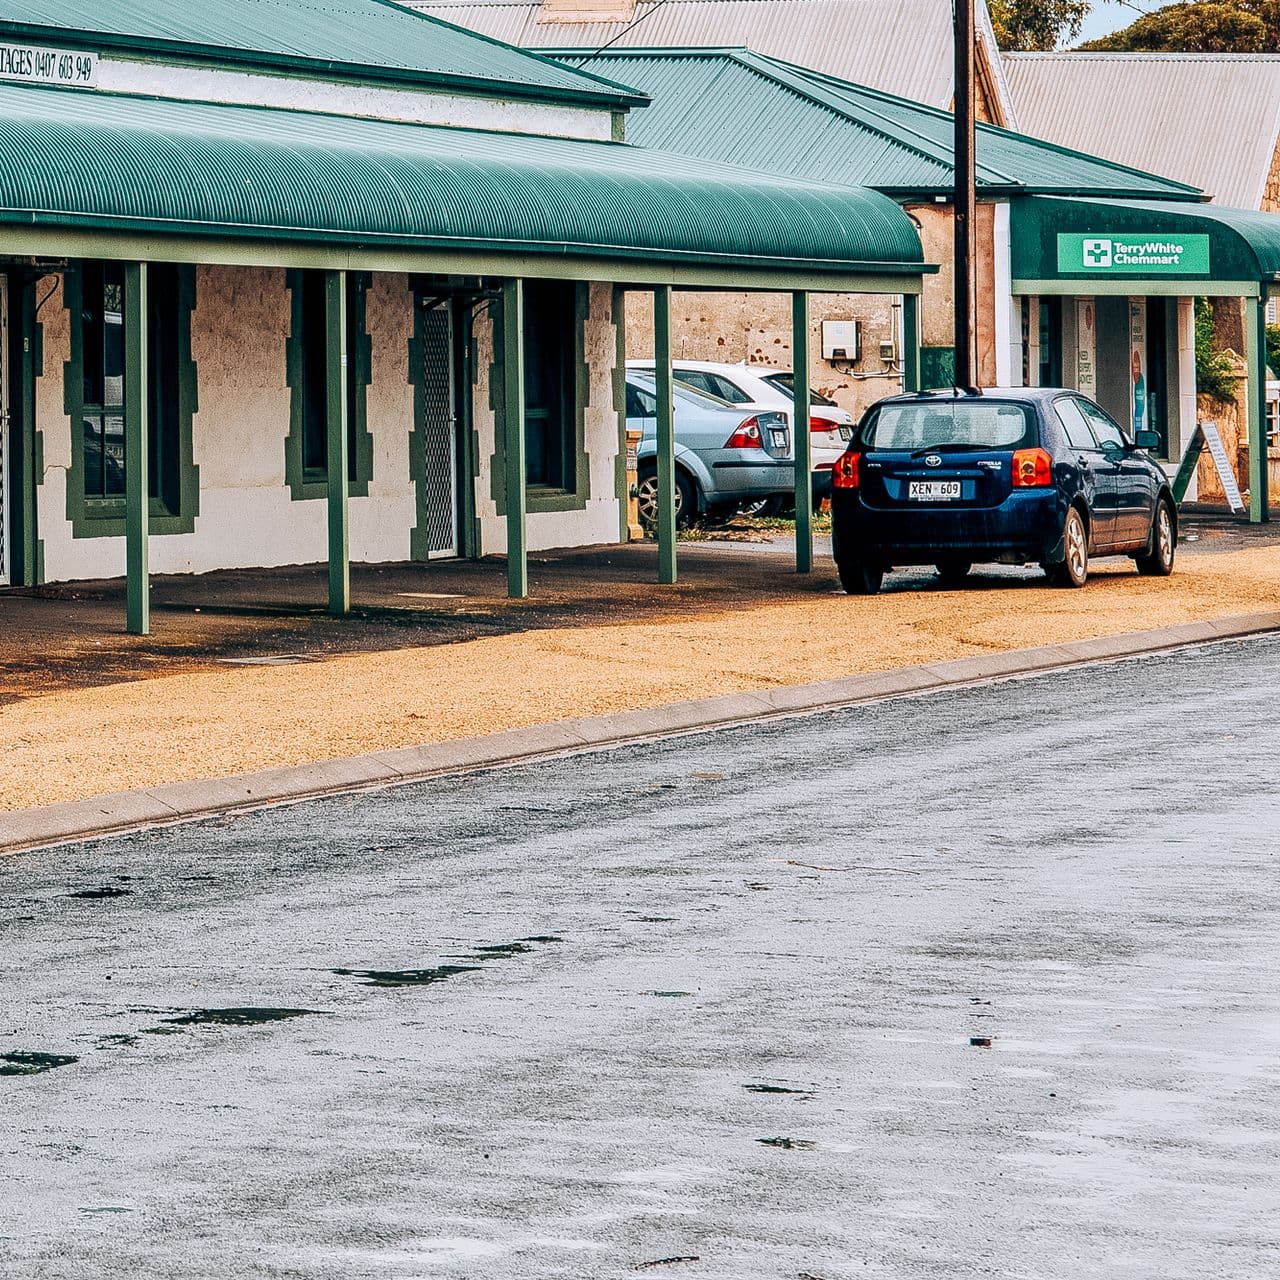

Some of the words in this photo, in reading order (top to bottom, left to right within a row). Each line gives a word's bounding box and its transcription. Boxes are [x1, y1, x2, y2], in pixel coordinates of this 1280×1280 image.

[34, 52, 57, 79] 0407
[58, 54, 74, 81] 603
[76, 56, 92, 82] 949
[1113, 242, 1184, 257] TerryWhite
[1113, 254, 1180, 265] Chemmart
[911, 483, 933, 495] XEN
[940, 483, 959, 495] 609
